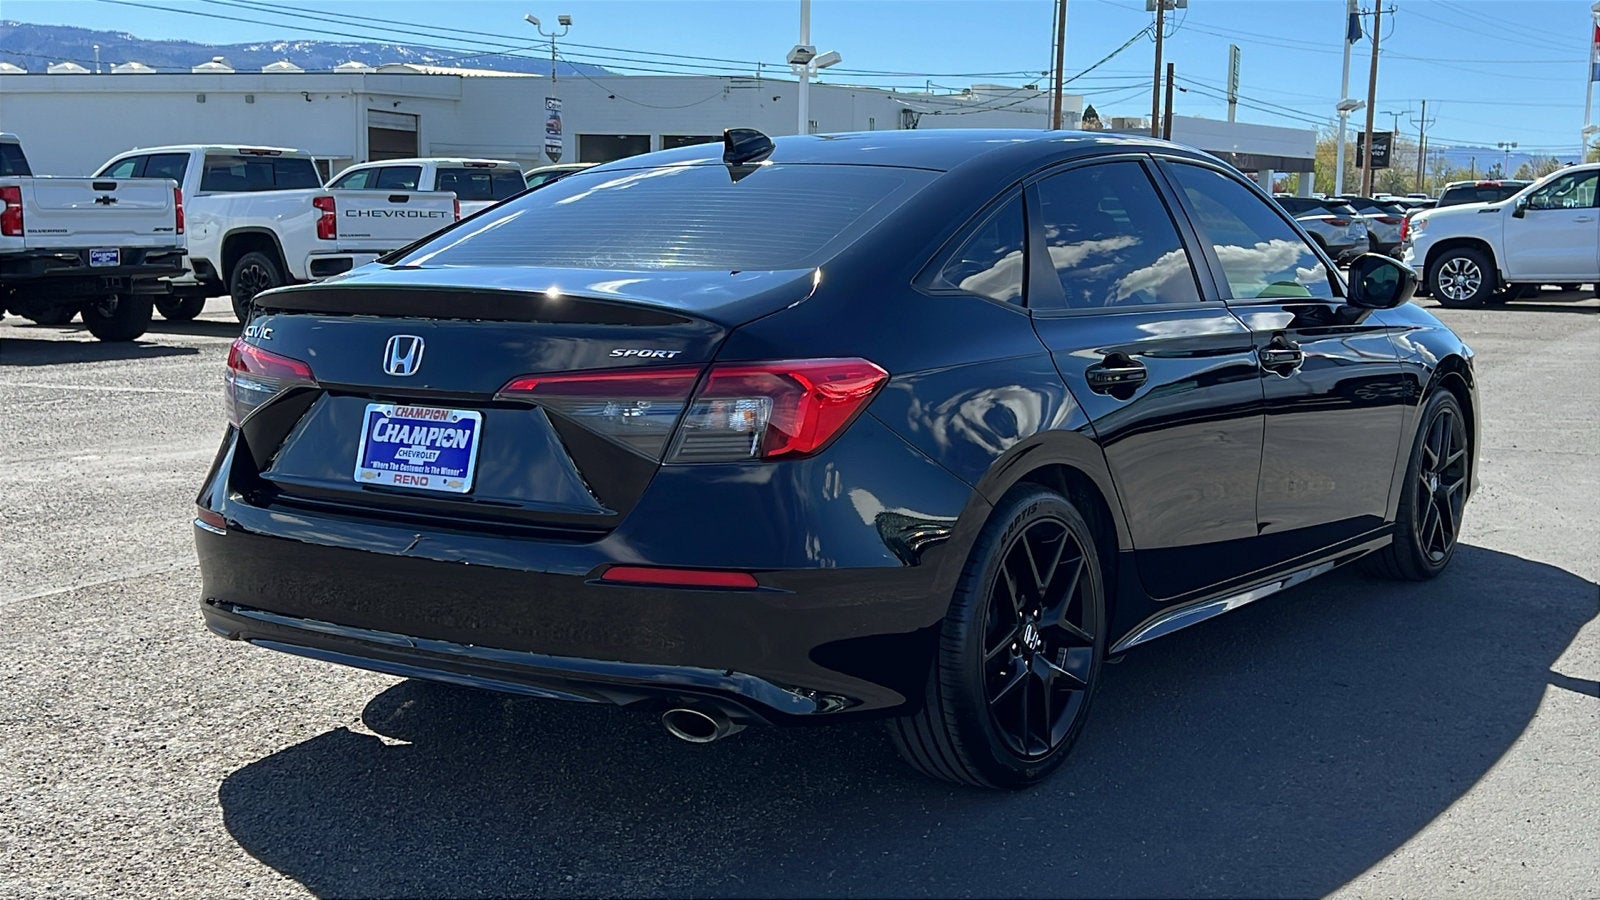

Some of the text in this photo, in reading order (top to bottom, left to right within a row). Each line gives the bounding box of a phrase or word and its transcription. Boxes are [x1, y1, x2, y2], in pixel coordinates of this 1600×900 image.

[345, 209, 448, 219] CHEVROLET
[245, 326, 273, 340] CIVIC
[609, 348, 682, 358] SPORT
[395, 406, 449, 420] CHAMPION
[372, 417, 471, 449] CHAMPION
[398, 449, 437, 460] CHEVROLET
[390, 462, 399, 471] The
[400, 463, 424, 473] Customer
[431, 466, 440, 475] The
[393, 474, 429, 486] RENO
